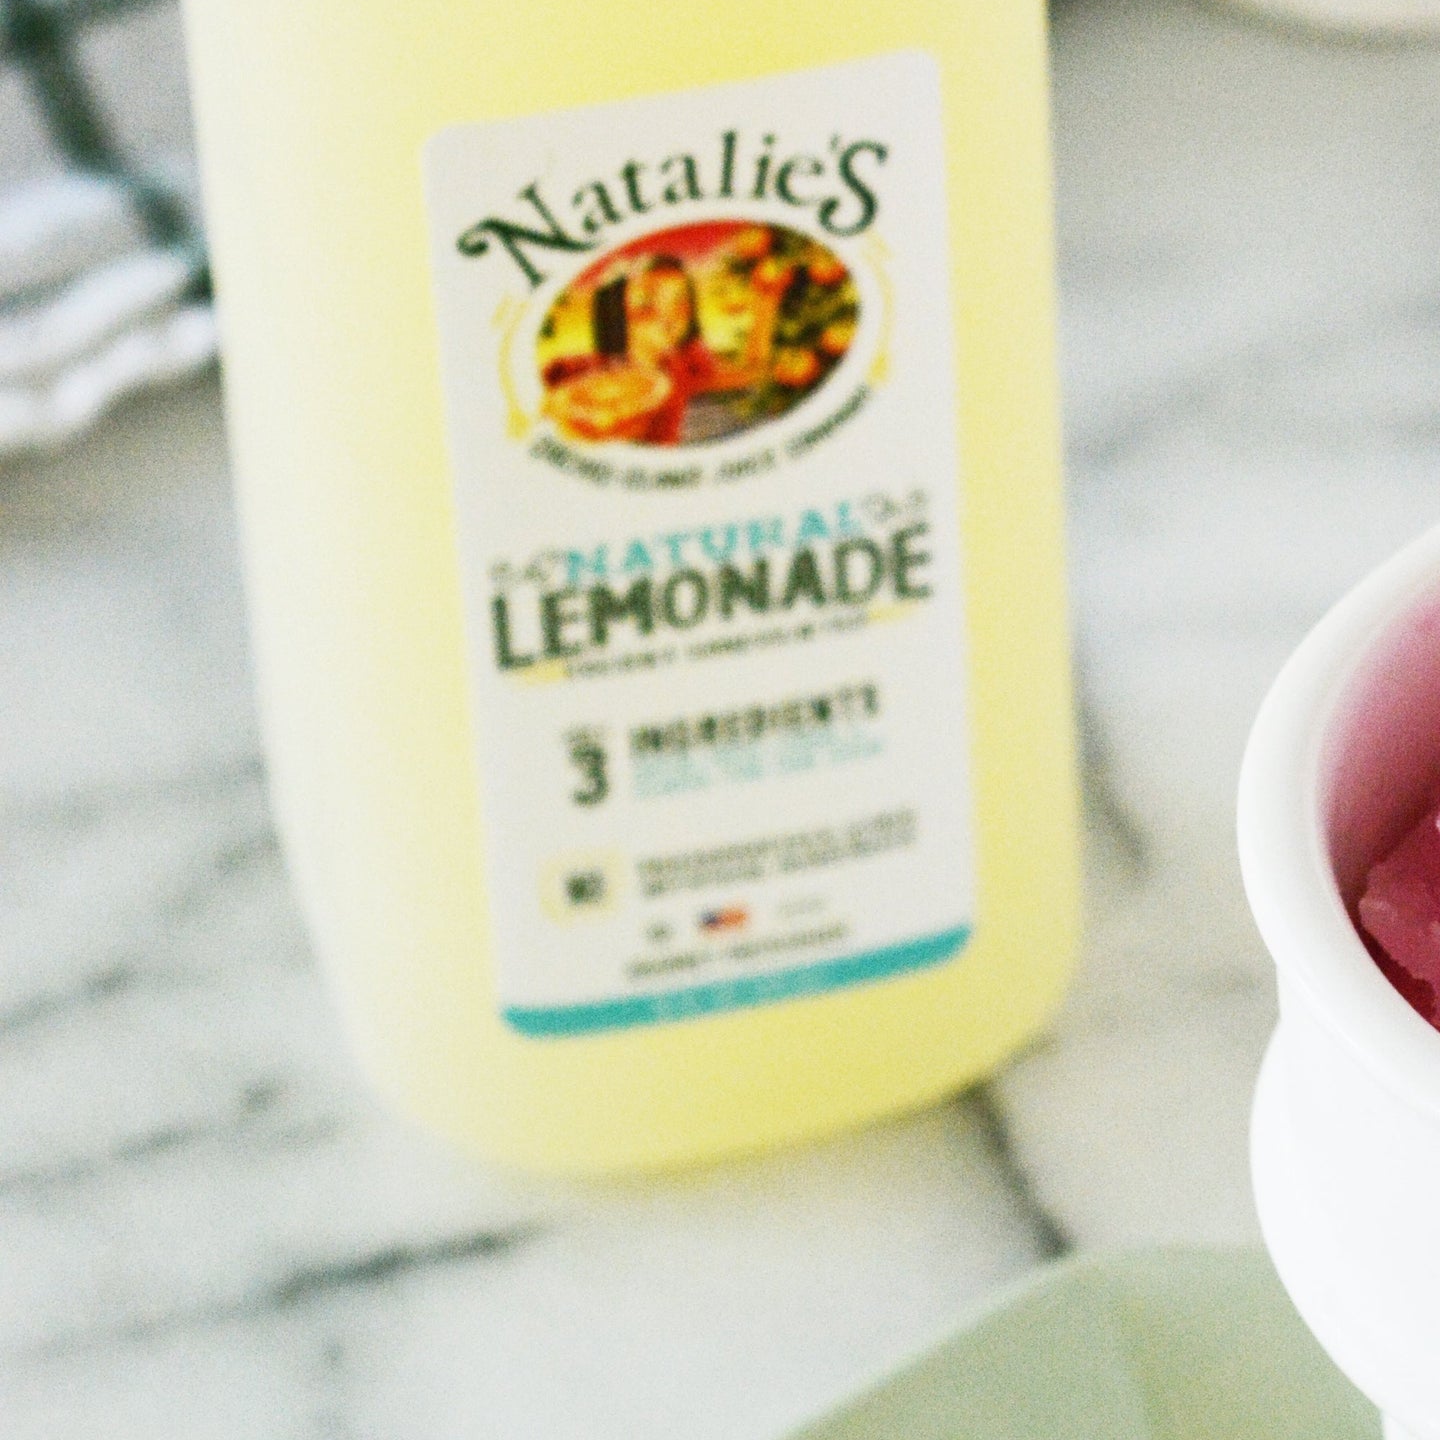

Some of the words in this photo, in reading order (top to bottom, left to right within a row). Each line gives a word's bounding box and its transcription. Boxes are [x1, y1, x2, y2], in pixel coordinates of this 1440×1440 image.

[565, 499, 863, 585] NATURAL
[490, 519, 935, 672] LEMONADE
[570, 742, 609, 808] 3
